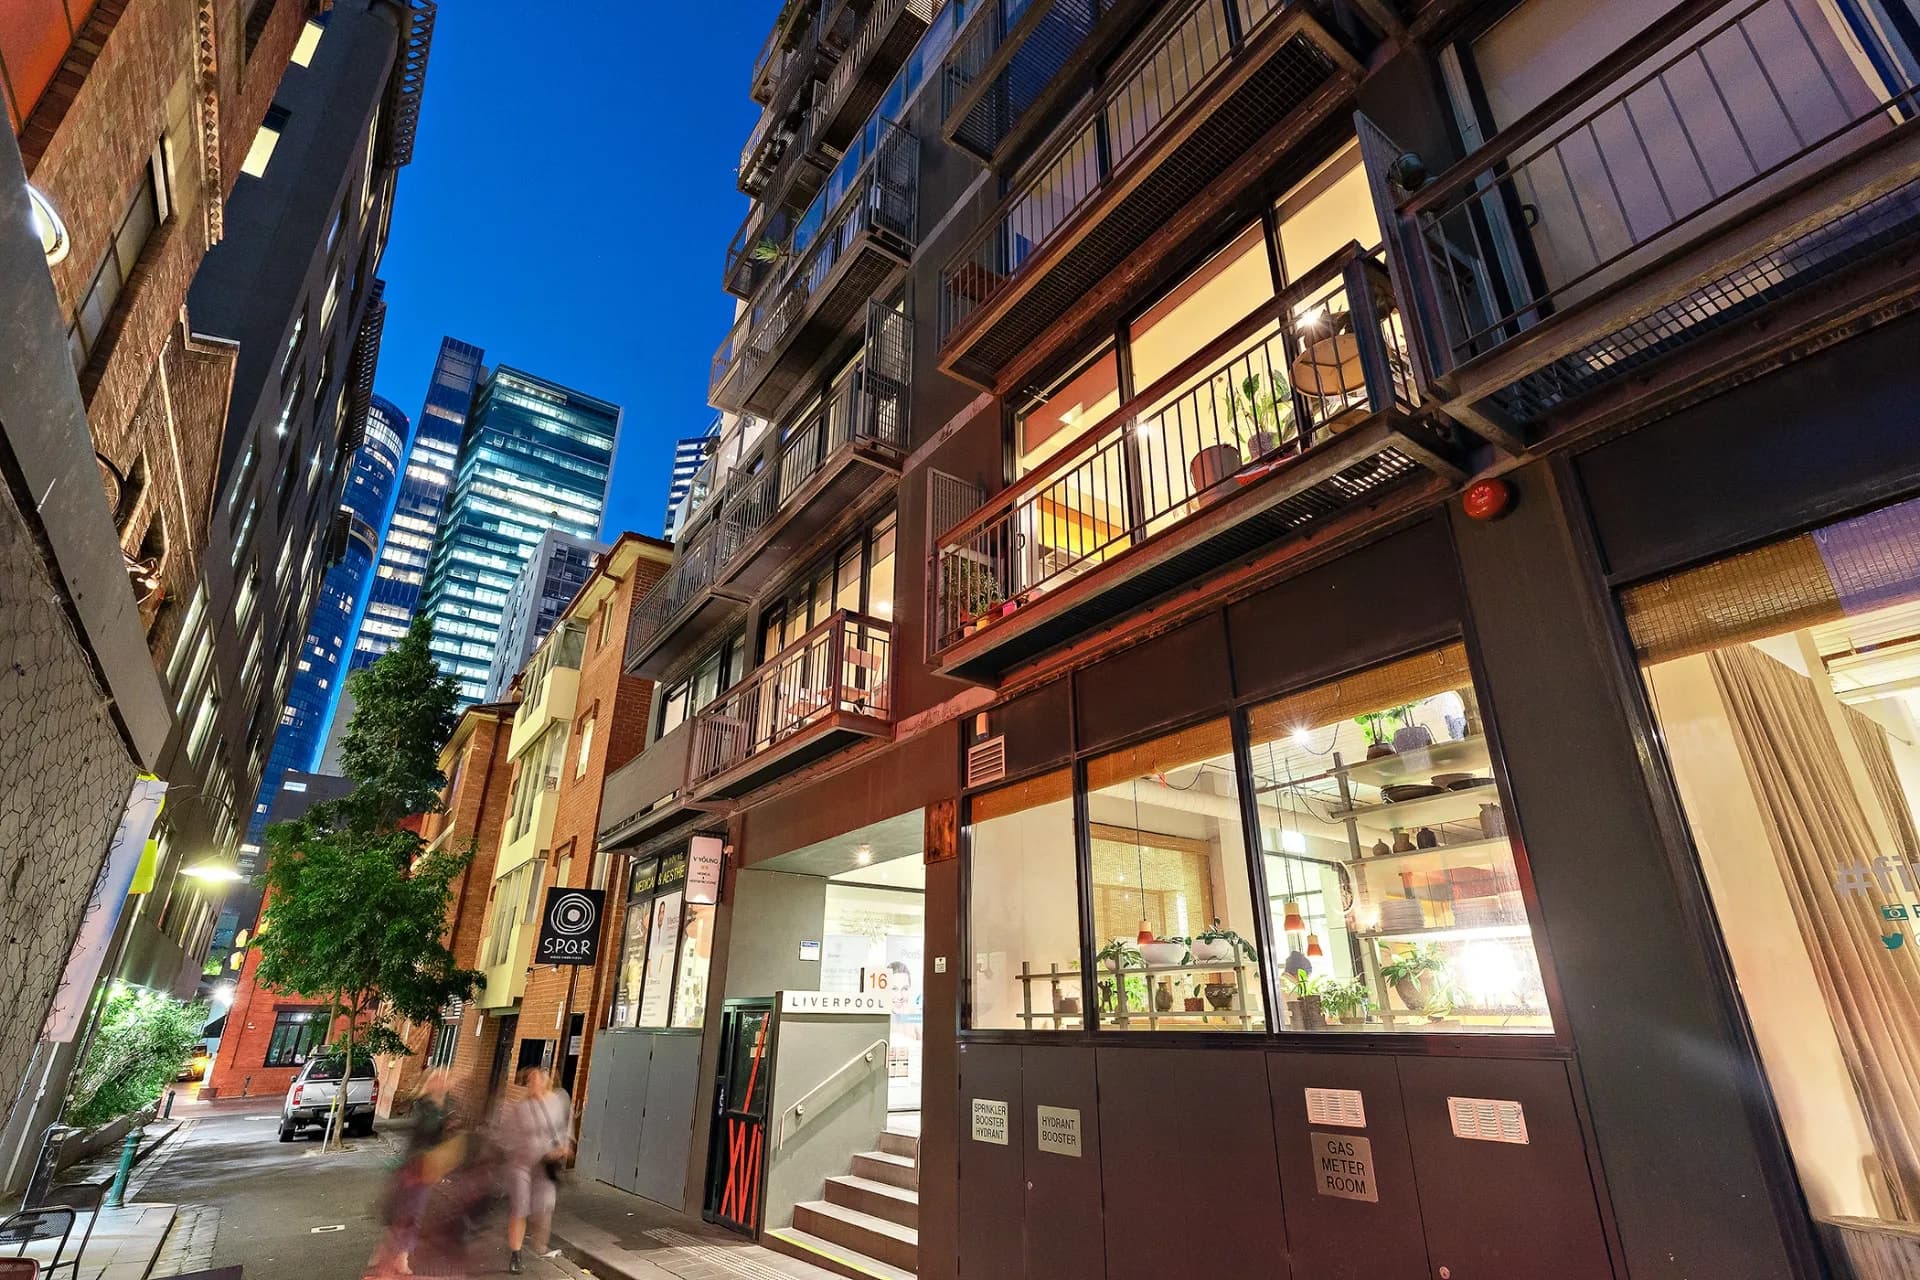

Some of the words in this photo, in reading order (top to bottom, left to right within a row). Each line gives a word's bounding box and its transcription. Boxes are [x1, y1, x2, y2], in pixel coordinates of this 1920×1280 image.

[869, 973, 888, 990] 16
[791, 996, 884, 1009] LIVERPOOL
[974, 1103, 1006, 1115] SPRINKLER
[976, 1115, 1004, 1127] BOOSTER
[1042, 1116, 1075, 1129] HYDRANT
[976, 1128, 1004, 1140] HYDRANT
[1042, 1131, 1076, 1145] BOOSTER
[1327, 1140, 1355, 1156] GAS
[1321, 1157, 1366, 1176] METER
[1326, 1175, 1367, 1194] ROOM
